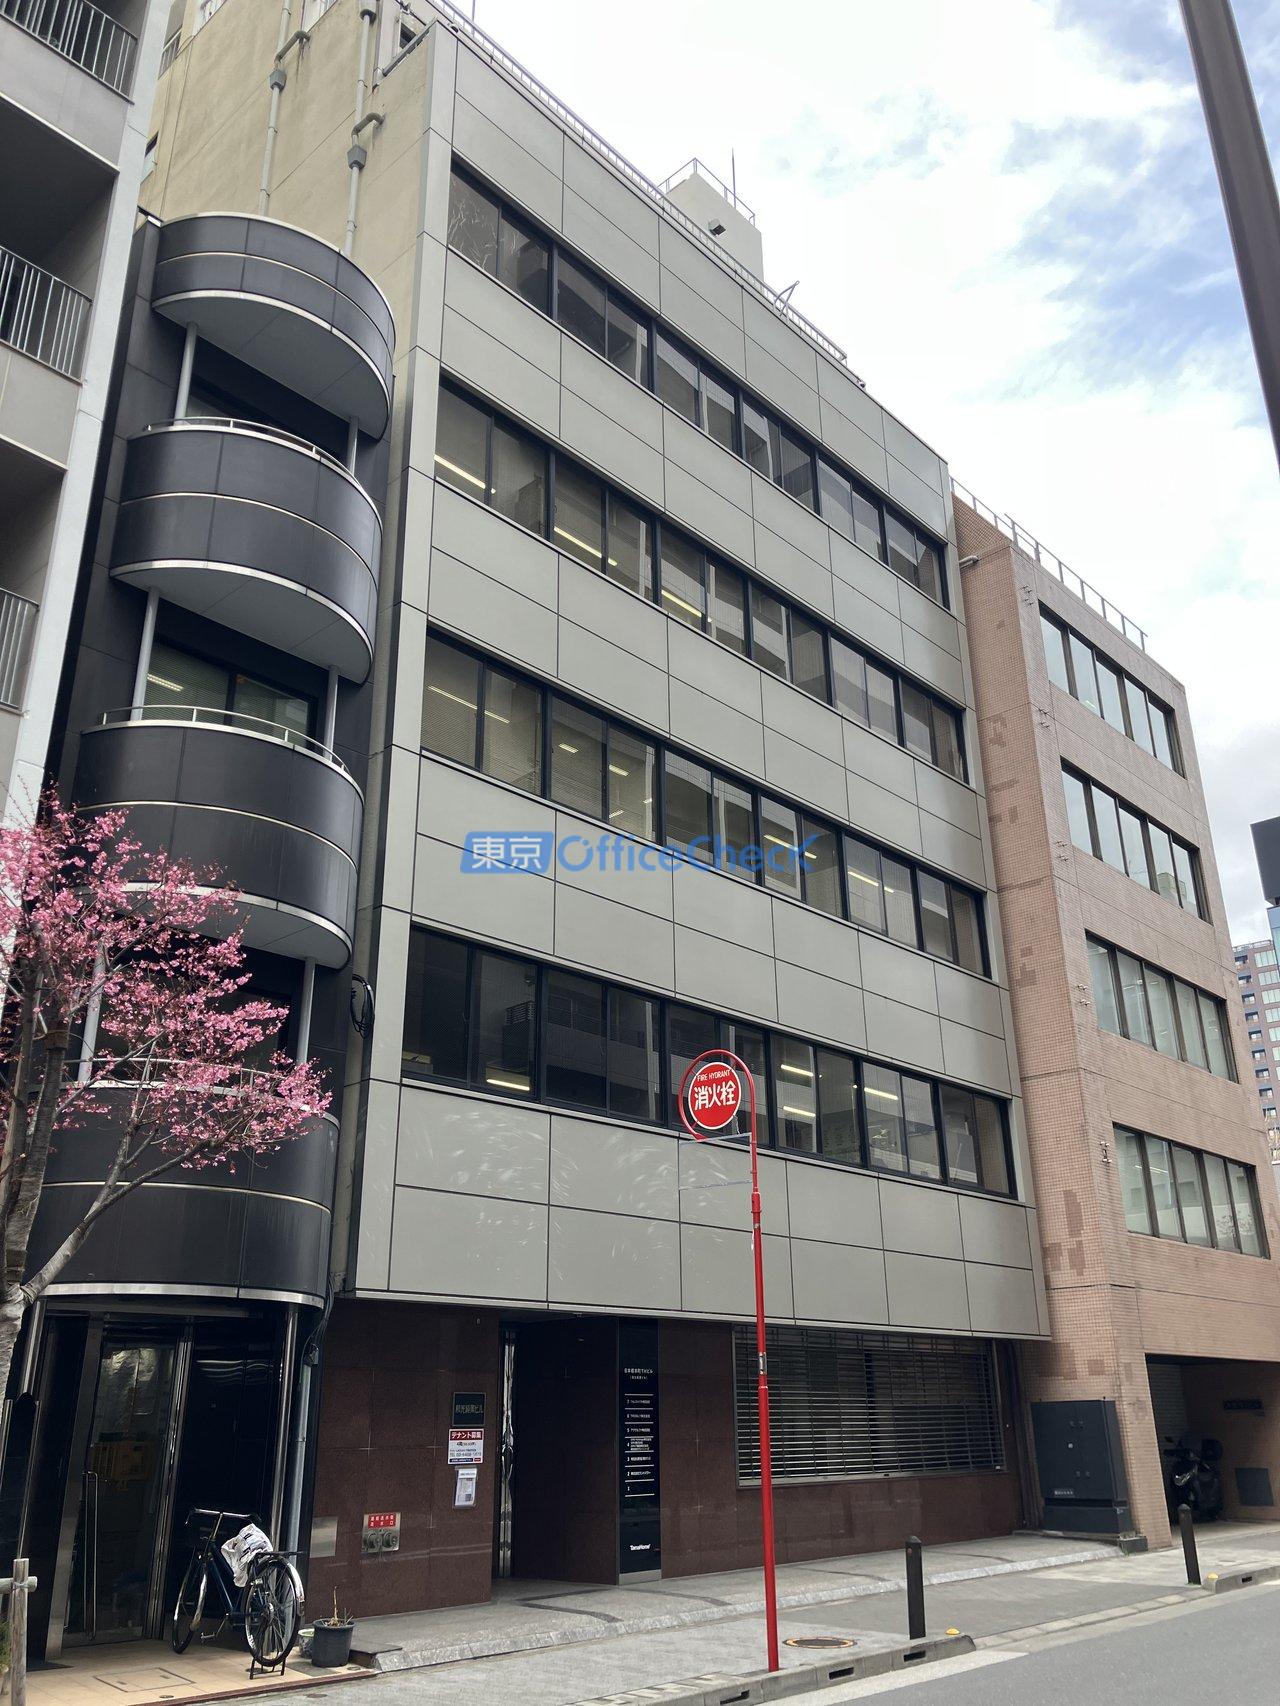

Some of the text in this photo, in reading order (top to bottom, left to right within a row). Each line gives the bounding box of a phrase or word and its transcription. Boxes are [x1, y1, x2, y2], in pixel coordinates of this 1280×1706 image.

[697, 1069, 731, 1082] FIRE HYDRANT
[693, 1080, 737, 1111] 消火栓
[451, 1431, 482, 1439] テナント募集
